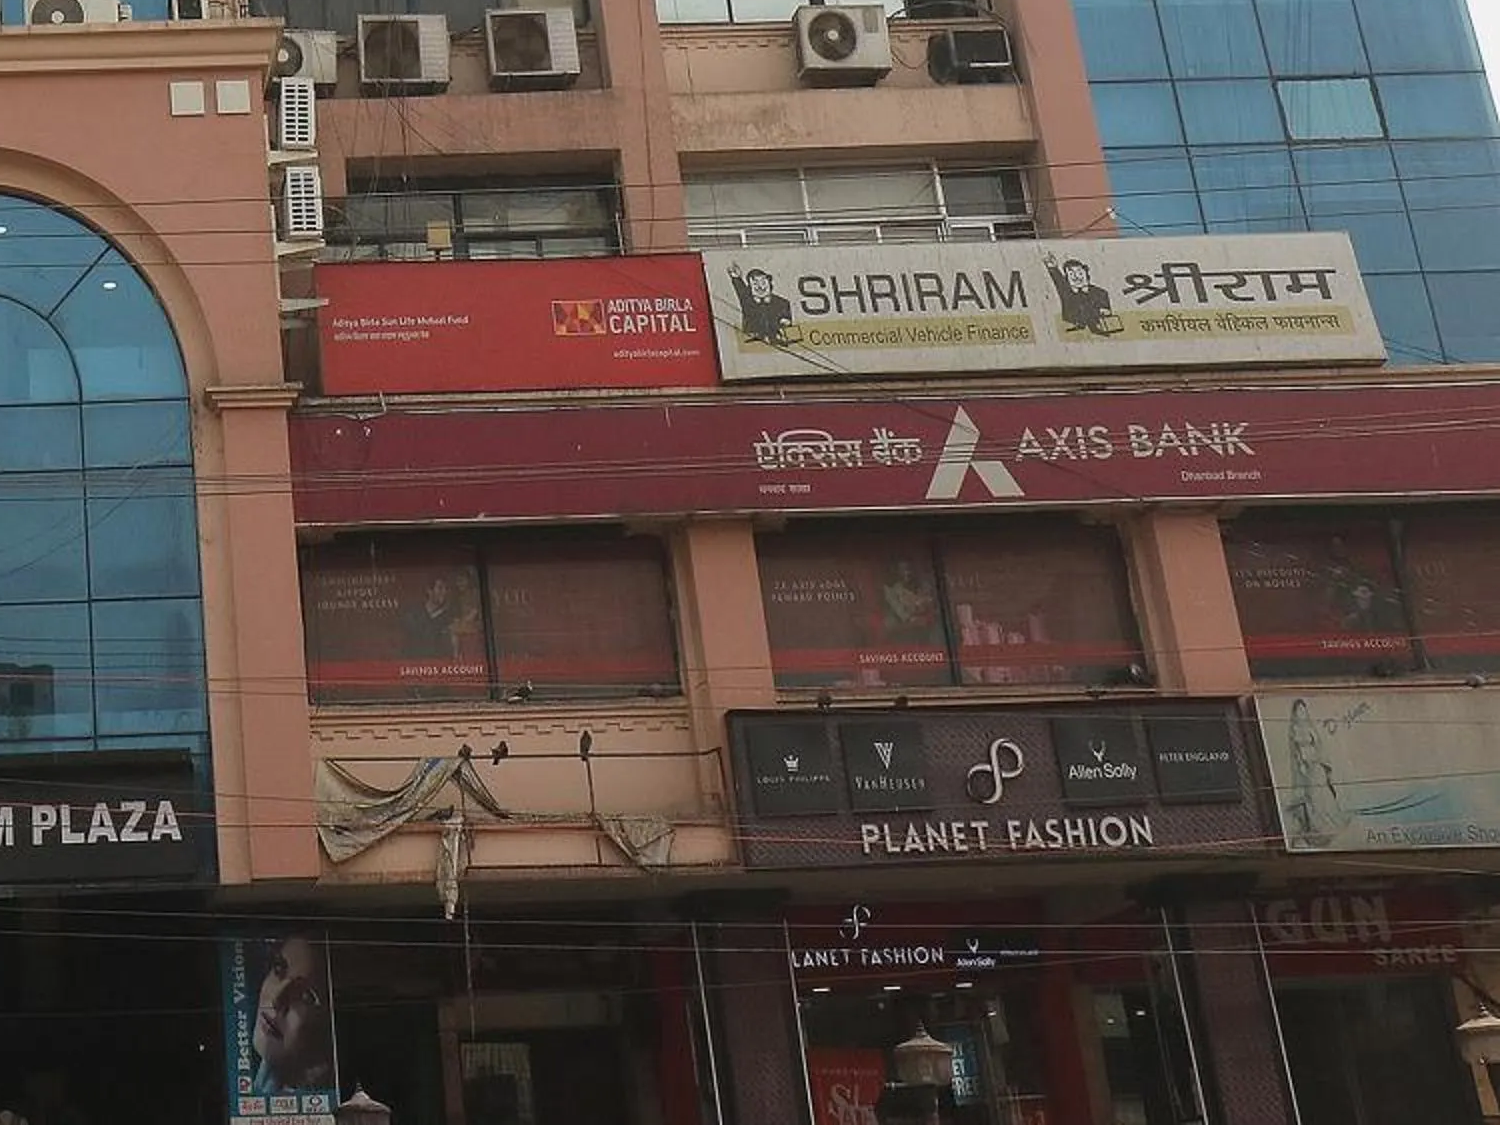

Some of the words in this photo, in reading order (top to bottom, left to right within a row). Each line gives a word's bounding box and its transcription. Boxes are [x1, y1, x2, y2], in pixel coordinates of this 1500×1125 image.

[799, 269, 1029, 315] SHRIRAM
[1122, 261, 1336, 305] श्रीराम
[607, 297, 652, 313] ADITYA
[654, 297, 693, 312] BIRLA
[609, 314, 697, 334] CAPITAL
[808, 326, 900, 345] Commercial
[908, 324, 963, 344] Vehicle
[967, 322, 1029, 341] Finance
[1015, 426, 1113, 461] AXIS
[1128, 421, 1256, 457] BANK
[901, 652, 944, 663] ACCOUNT
[441, 665, 483, 675] ACCOUNT
[1068, 764, 1100, 780] Allen
[1103, 762, 1137, 780] Solly
[30, 799, 183, 845] PLAZA
[861, 820, 989, 854] PLANET
[1009, 815, 1154, 851] FASHION
[1365, 826, 1388, 843] An
[861, 947, 946, 966] FASHION
[1371, 944, 1457, 966] SAREE
[233, 941, 246, 1003] Vision
[237, 1010, 250, 1071] Better
